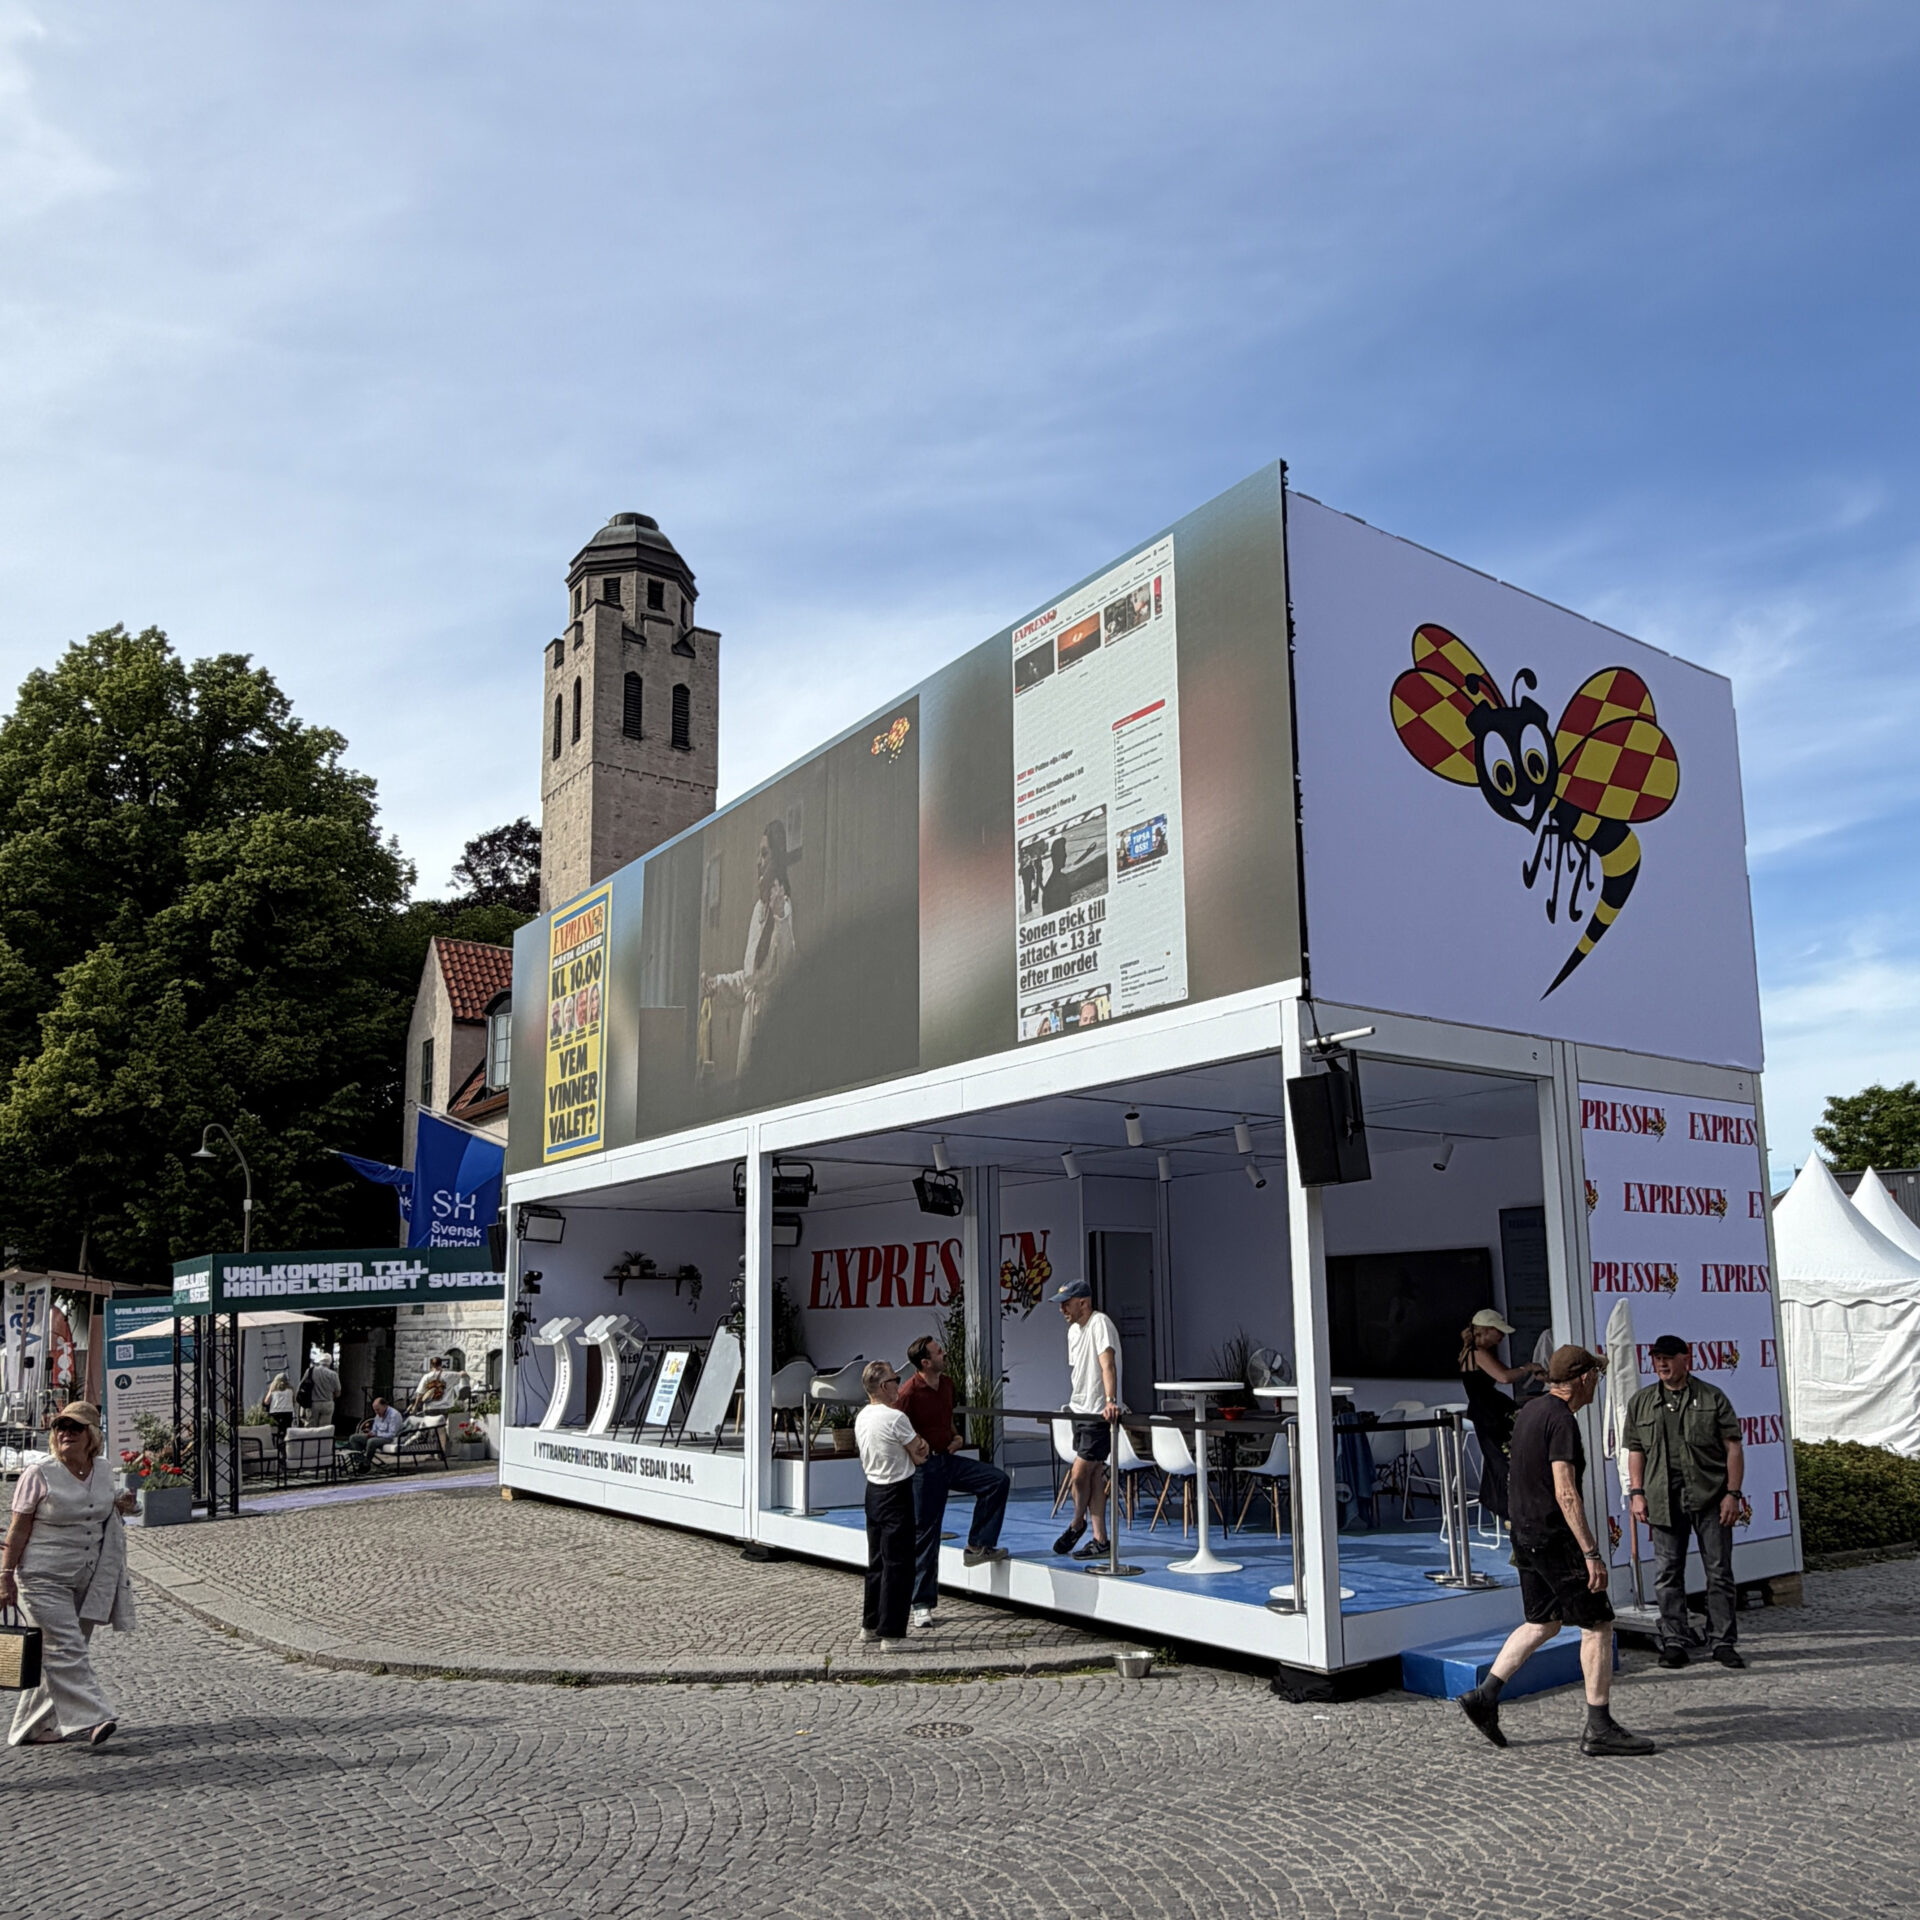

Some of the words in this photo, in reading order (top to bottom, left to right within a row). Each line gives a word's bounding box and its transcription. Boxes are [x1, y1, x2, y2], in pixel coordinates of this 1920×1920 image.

[1020, 807, 1104, 849] EXTRA
[1133, 831, 1150, 844] TIPSA
[1019, 920, 1056, 945] Sonen
[1059, 907, 1086, 935] gick
[1088, 899, 1106, 922] till
[1019, 941, 1058, 967] attack
[1070, 932, 1085, 951] 13
[1088, 925, 1102, 946] år
[552, 968, 566, 1001] KL
[570, 949, 602, 992] 10.00
[1020, 966, 1049, 990] efter
[1052, 950, 1098, 980] mordet
[559, 1042, 588, 1079] VEM
[549, 1071, 598, 1113] VINNER
[549, 1103, 595, 1144] VALET?
[432, 1189, 476, 1220] SH
[431, 1221, 482, 1238] Svensk
[223, 1274, 421, 1298] HANDELSLANDET
[371, 1260, 429, 1276] TILL
[538, 1442, 608, 1470] YTTRANDEFRIHETENS
[611, 1452, 638, 1475] TJÄNST
[640, 1458, 667, 1480] SEDAN
[670, 1462, 694, 1484] 1944.
